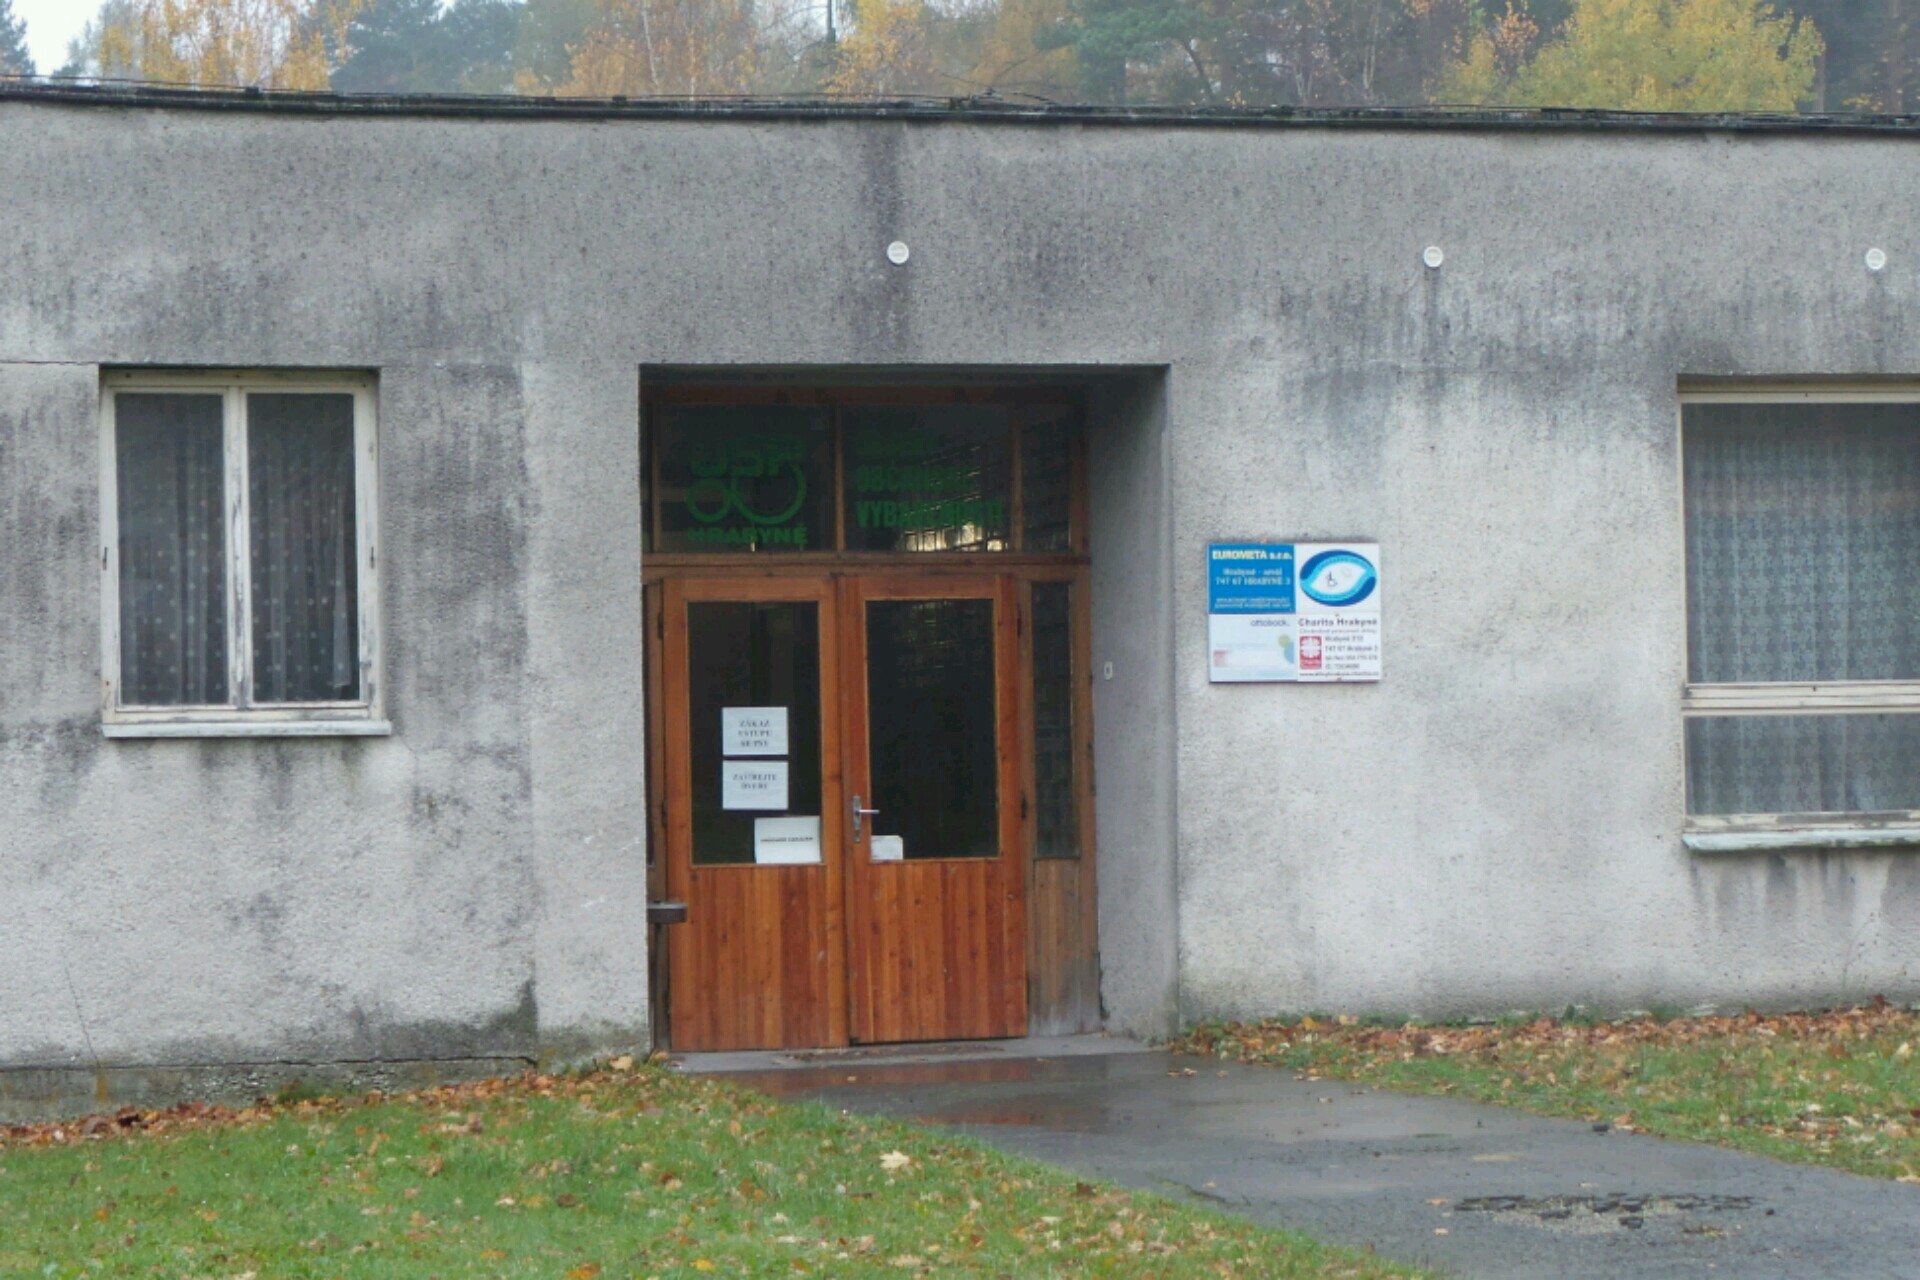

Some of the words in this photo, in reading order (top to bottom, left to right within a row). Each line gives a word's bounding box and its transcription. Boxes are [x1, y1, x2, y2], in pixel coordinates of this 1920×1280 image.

[1212, 549, 1267, 560] EUROMETA
[1269, 551, 1293, 560] s.r.o.
[1298, 617, 1334, 626] Charita
[1337, 617, 1377, 628] Hrabyně
